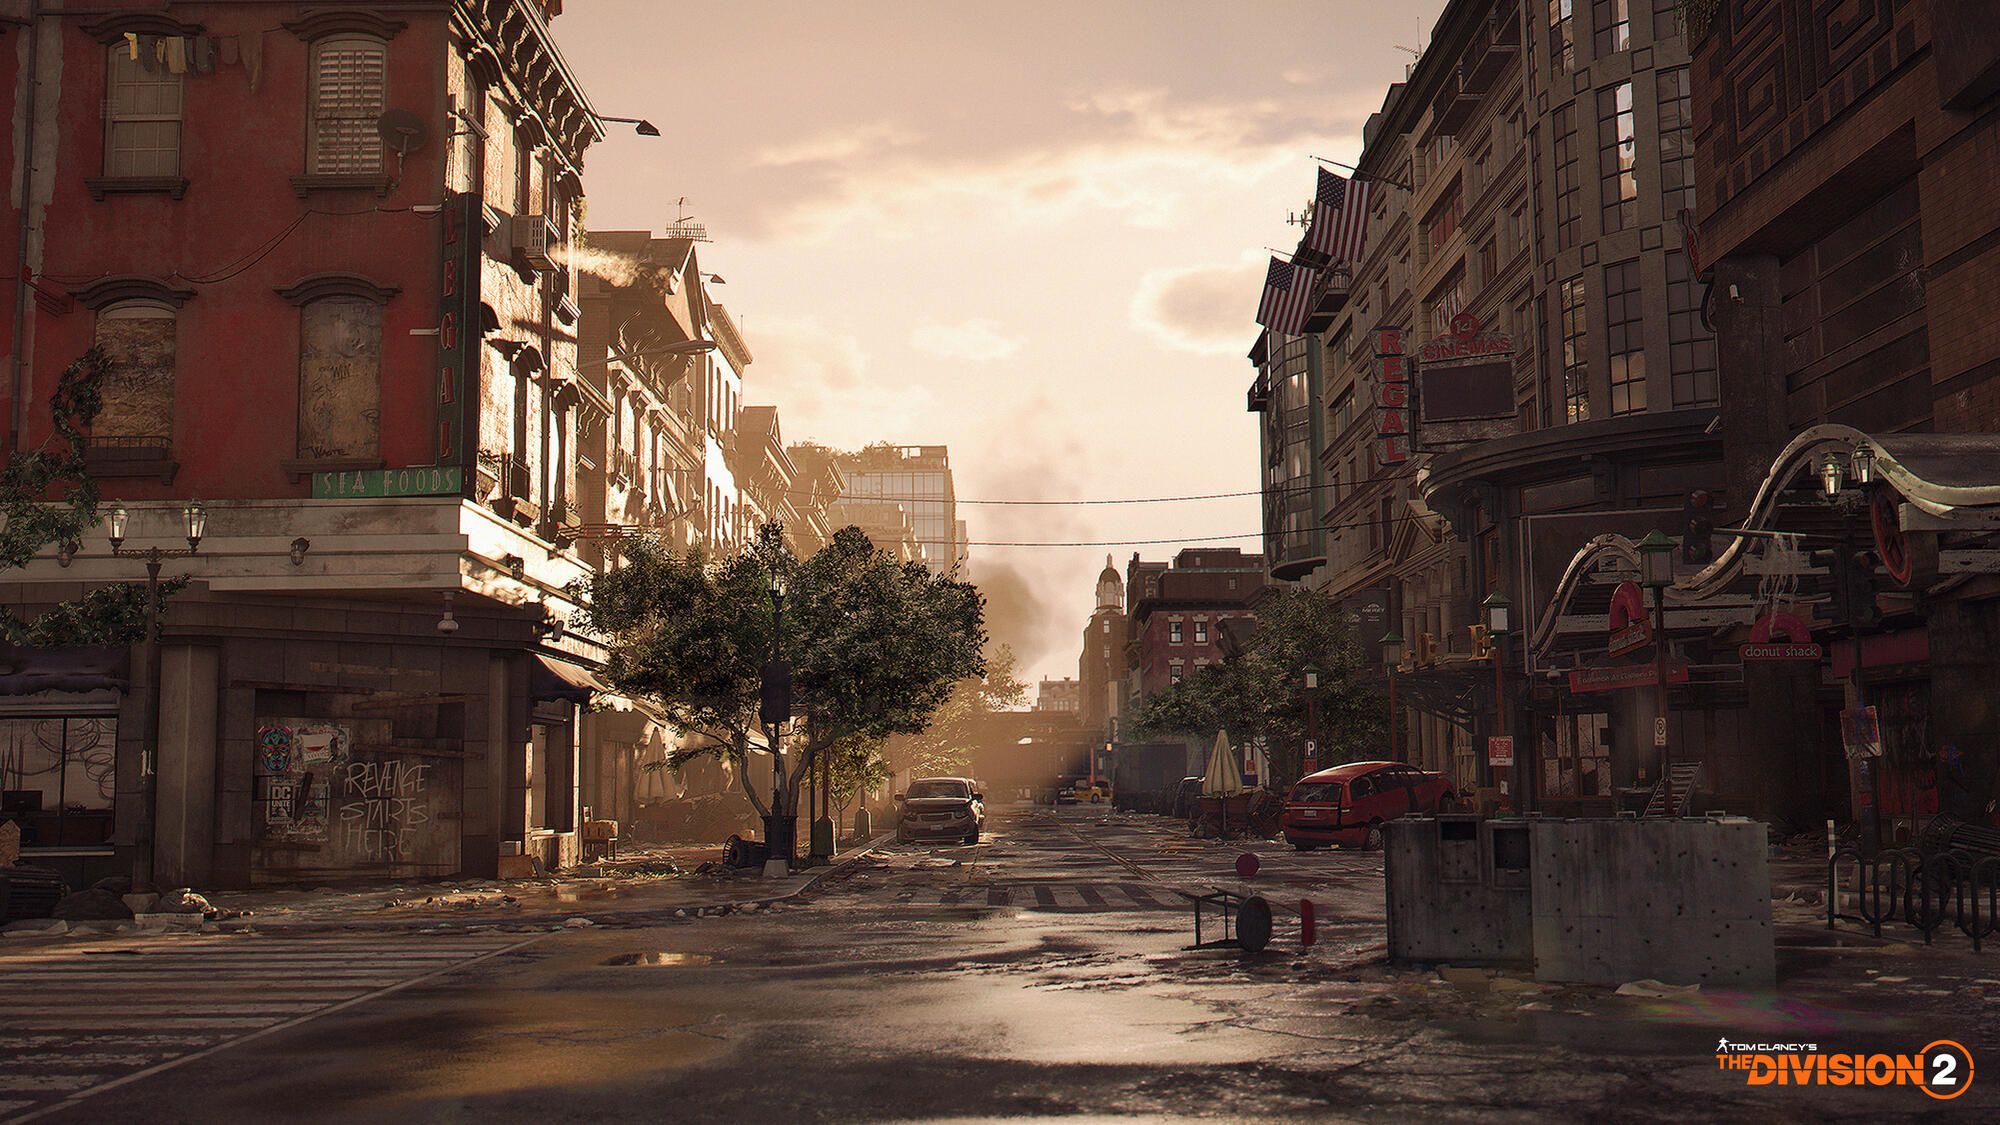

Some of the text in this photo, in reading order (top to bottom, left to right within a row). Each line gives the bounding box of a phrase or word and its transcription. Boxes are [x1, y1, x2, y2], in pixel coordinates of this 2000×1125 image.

[1454, 319, 1474, 334] 14
[1423, 338, 1511, 359] CINEMAS
[1381, 330, 1406, 461] REGAL
[323, 469, 454, 496] SEA FOODS
[1744, 645, 1818, 657] donut shack
[1307, 741, 1315, 757] P
[344, 760, 432, 798] REVENGE
[272, 786, 292, 800] DC
[340, 797, 429, 828] STARTS
[345, 824, 417, 862] HERE
